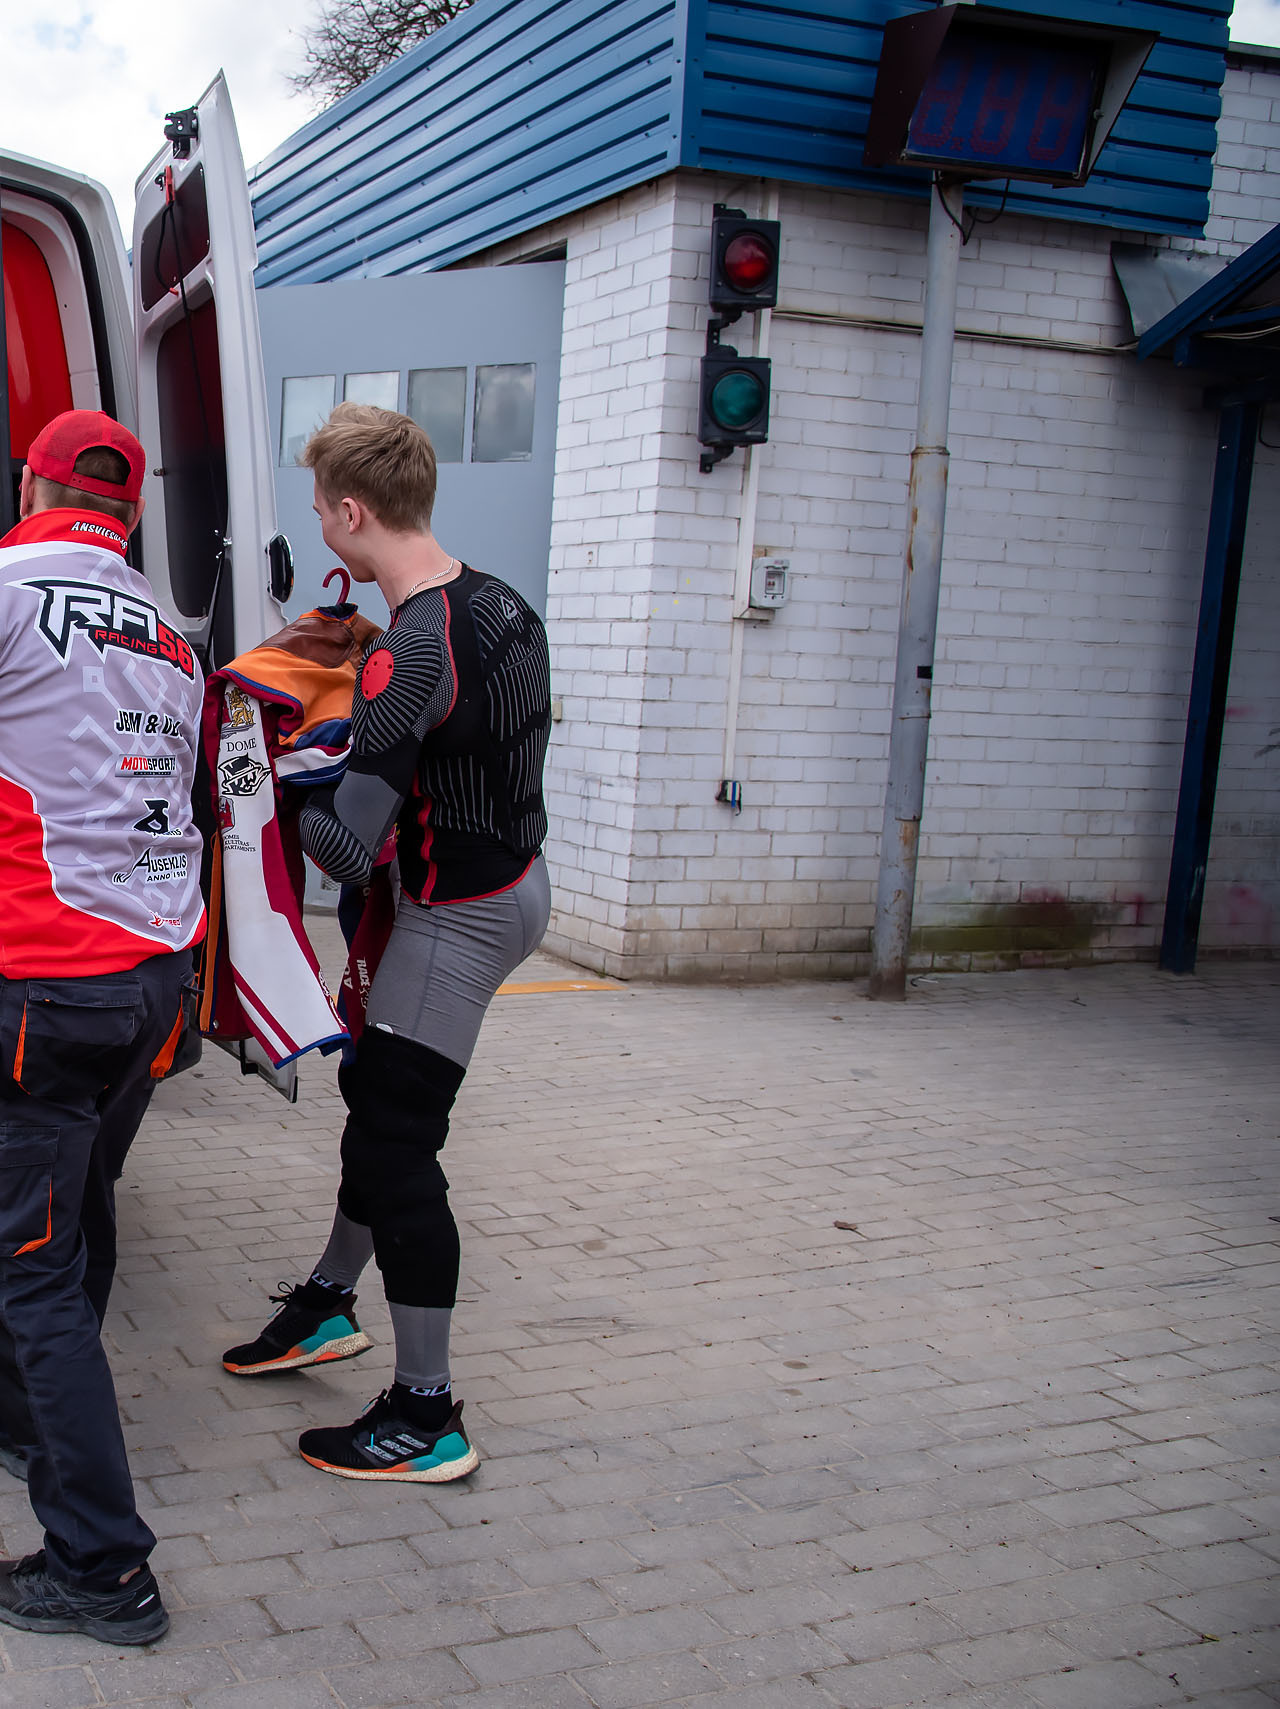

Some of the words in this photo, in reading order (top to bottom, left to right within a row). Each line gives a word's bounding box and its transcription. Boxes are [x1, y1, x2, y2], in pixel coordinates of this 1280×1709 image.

[95, 629, 158, 655] RACING
[116, 710, 143, 734] JBM
[145, 714, 160, 734] &
[226, 738, 257, 752] DOME
[124, 848, 187, 882] AUSEKLIS
[147, 873, 170, 881] ANNO
